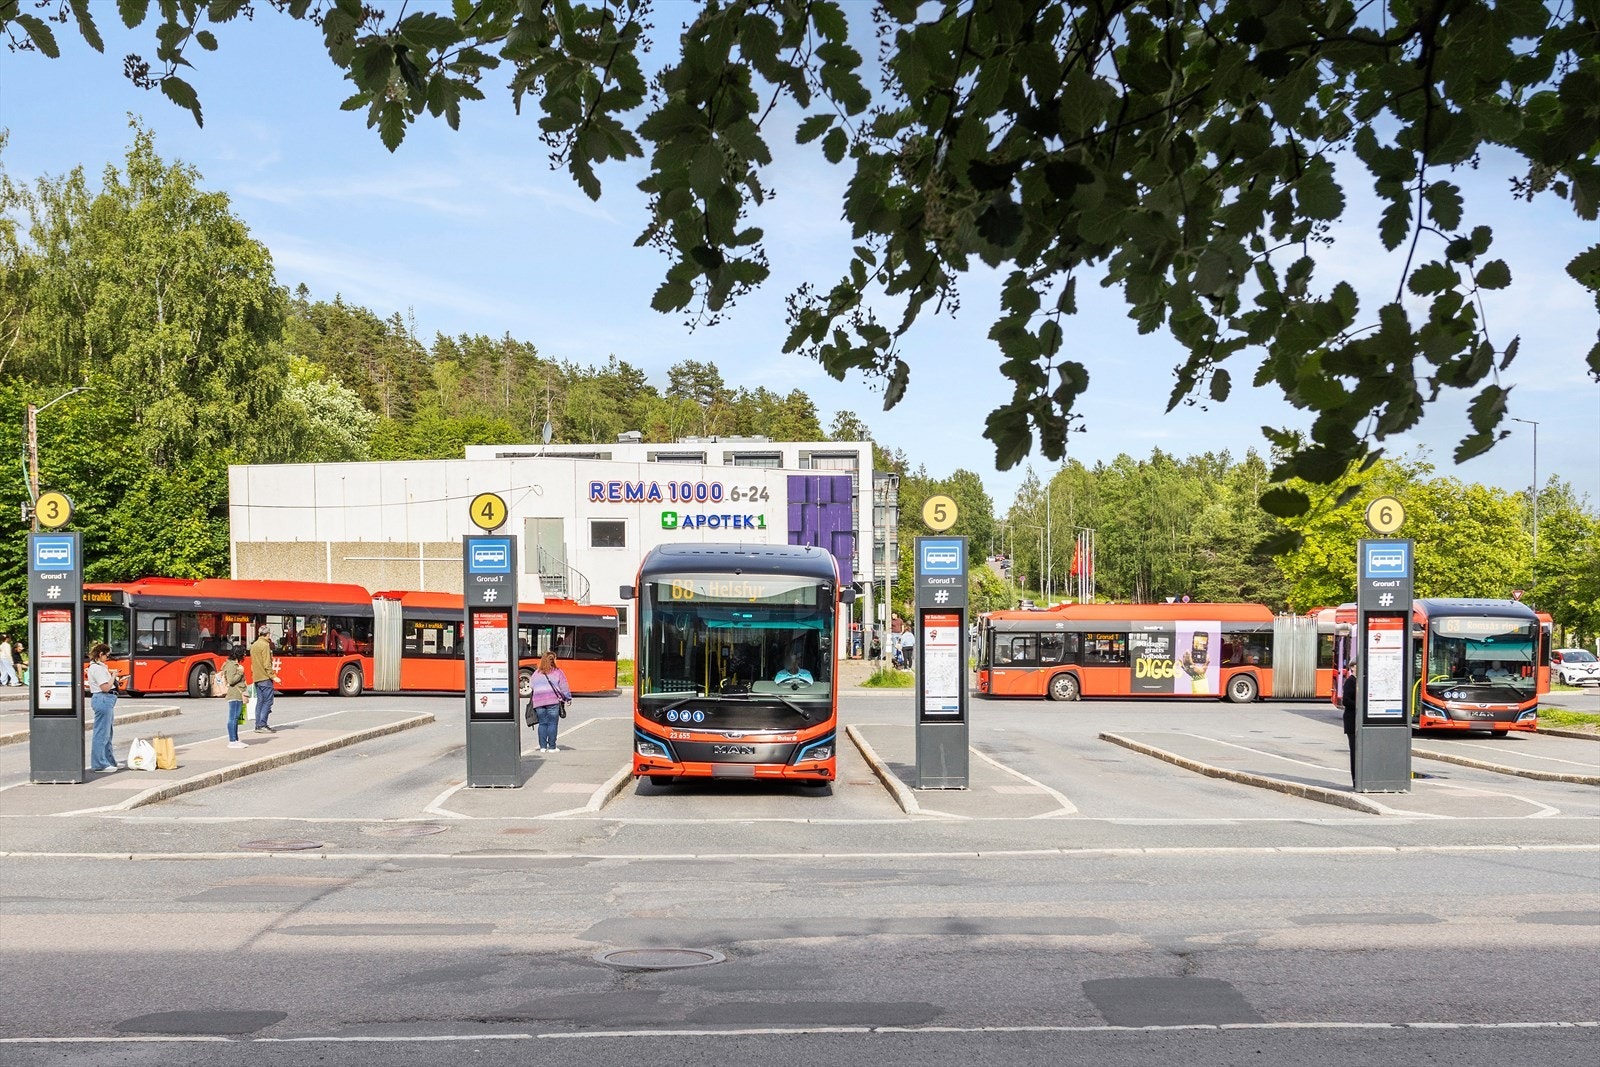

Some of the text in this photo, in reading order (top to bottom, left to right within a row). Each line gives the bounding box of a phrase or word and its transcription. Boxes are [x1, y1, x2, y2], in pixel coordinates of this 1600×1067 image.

[589, 480, 770, 503] REMA 1000 6-24
[46, 500, 59, 519] 3
[481, 502, 494, 520] 4
[933, 503, 947, 522] 5
[1380, 506, 1392, 525] 6
[681, 514, 767, 529] APOTEK 1
[91, 593, 112, 601] trafikk
[672, 579, 765, 602] 68 Helsfyr
[1447, 620, 1519, 632] 63 Romsås ring
[1147, 637, 1166, 649] dager
[714, 745, 756, 754] MAN
